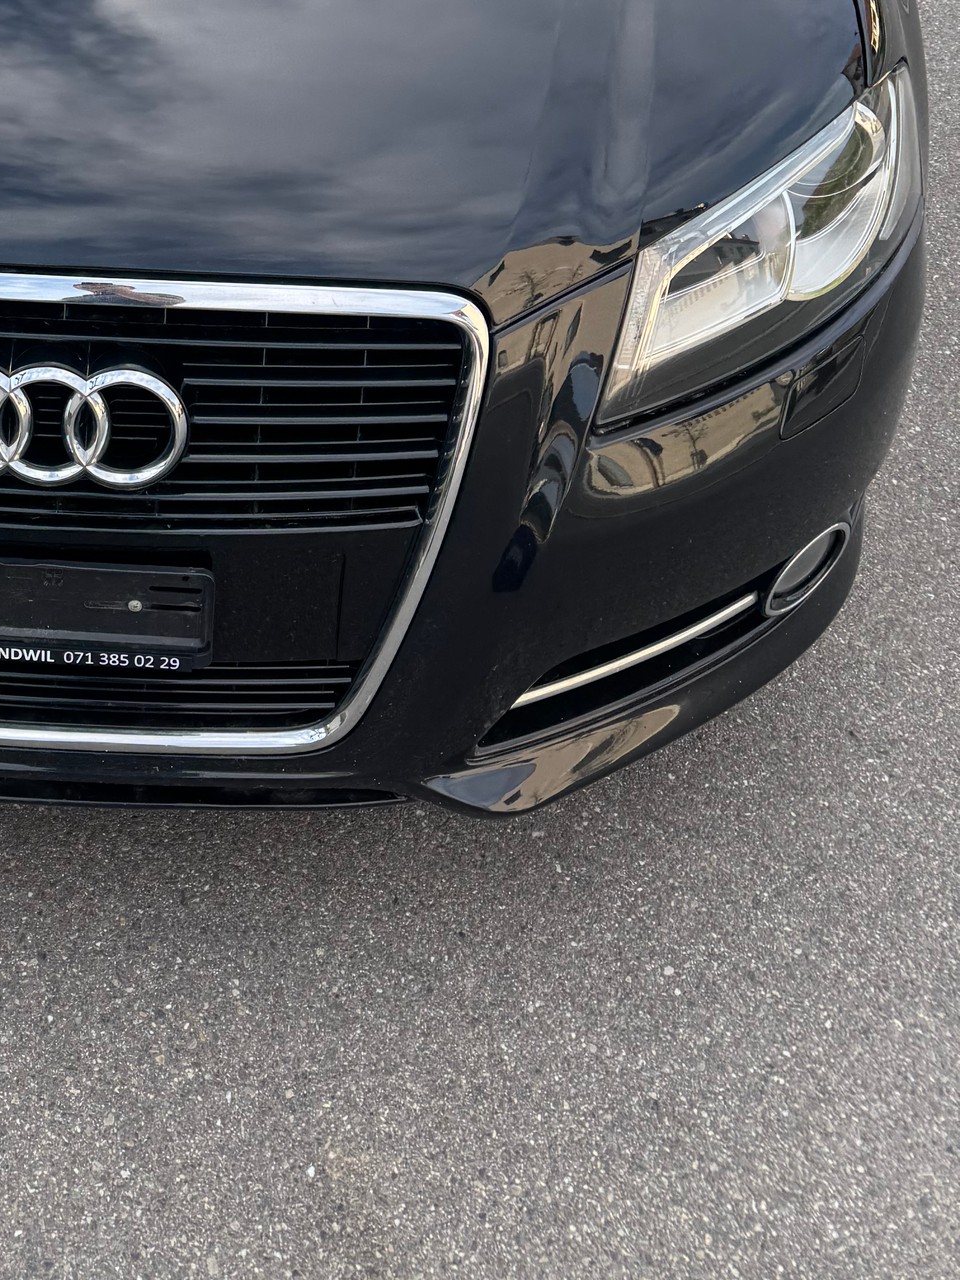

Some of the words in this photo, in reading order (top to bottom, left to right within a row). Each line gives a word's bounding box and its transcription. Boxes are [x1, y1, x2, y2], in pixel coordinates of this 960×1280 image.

[63, 651, 94, 665] 071
[98, 652, 129, 666] 385
[134, 654, 154, 668] 02
[159, 656, 180, 670] 29
